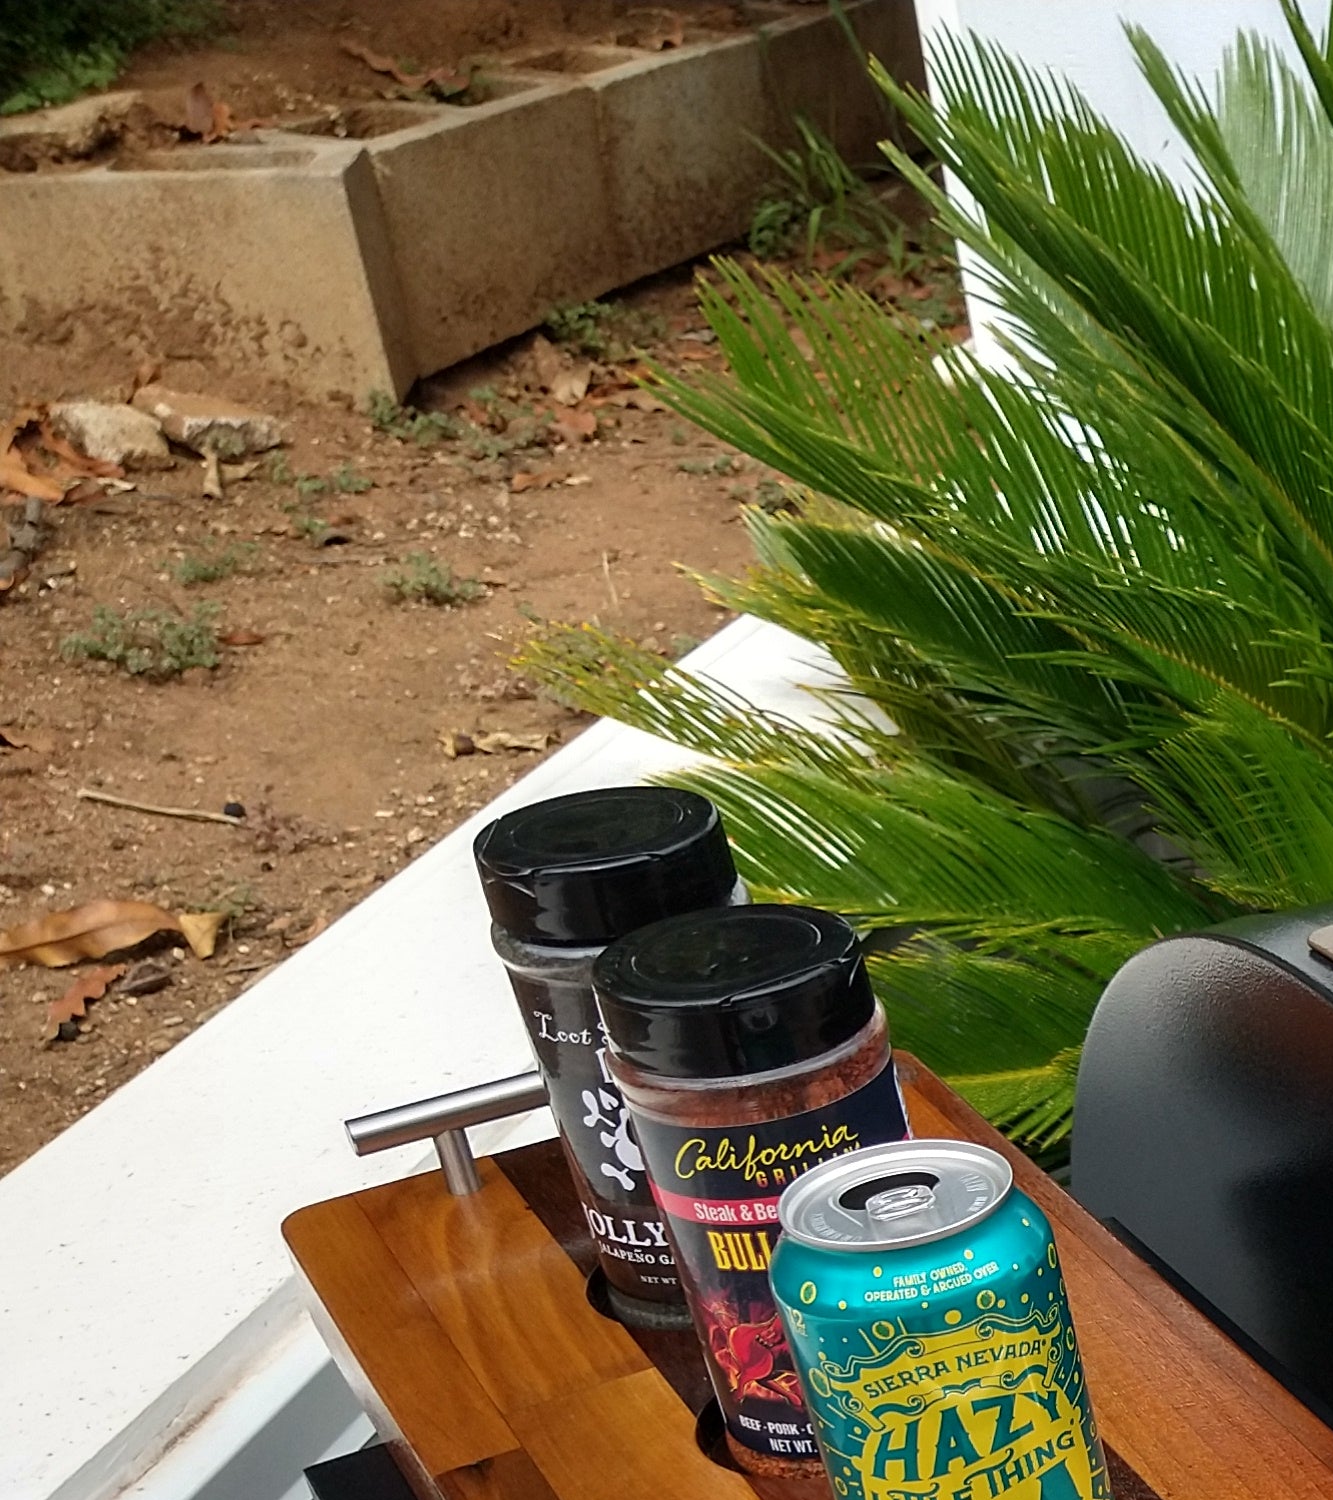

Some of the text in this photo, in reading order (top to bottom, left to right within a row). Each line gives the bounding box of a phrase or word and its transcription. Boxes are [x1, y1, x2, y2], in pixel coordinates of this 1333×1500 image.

[533, 1010, 592, 1045] Loot
[674, 1124, 859, 1181] California
[581, 1201, 669, 1247] JOLLY
[693, 1202, 778, 1222] Steak & Be
[598, 1241, 655, 1264] JALAPEÑO
[641, 1275, 659, 1284] NET
[864, 1261, 999, 1302] OPERATED & ARGUED OVER
[893, 1272, 926, 1288] FAMILY
[863, 1340, 1042, 1399] SIERRA NEVADA
[739, 1415, 761, 1431] BEEF
[766, 1422, 800, 1436] PORK
[871, 1389, 1064, 1482] HAZY
[769, 1437, 819, 1453] NET WT.
[963, 1430, 1075, 1498] THING
